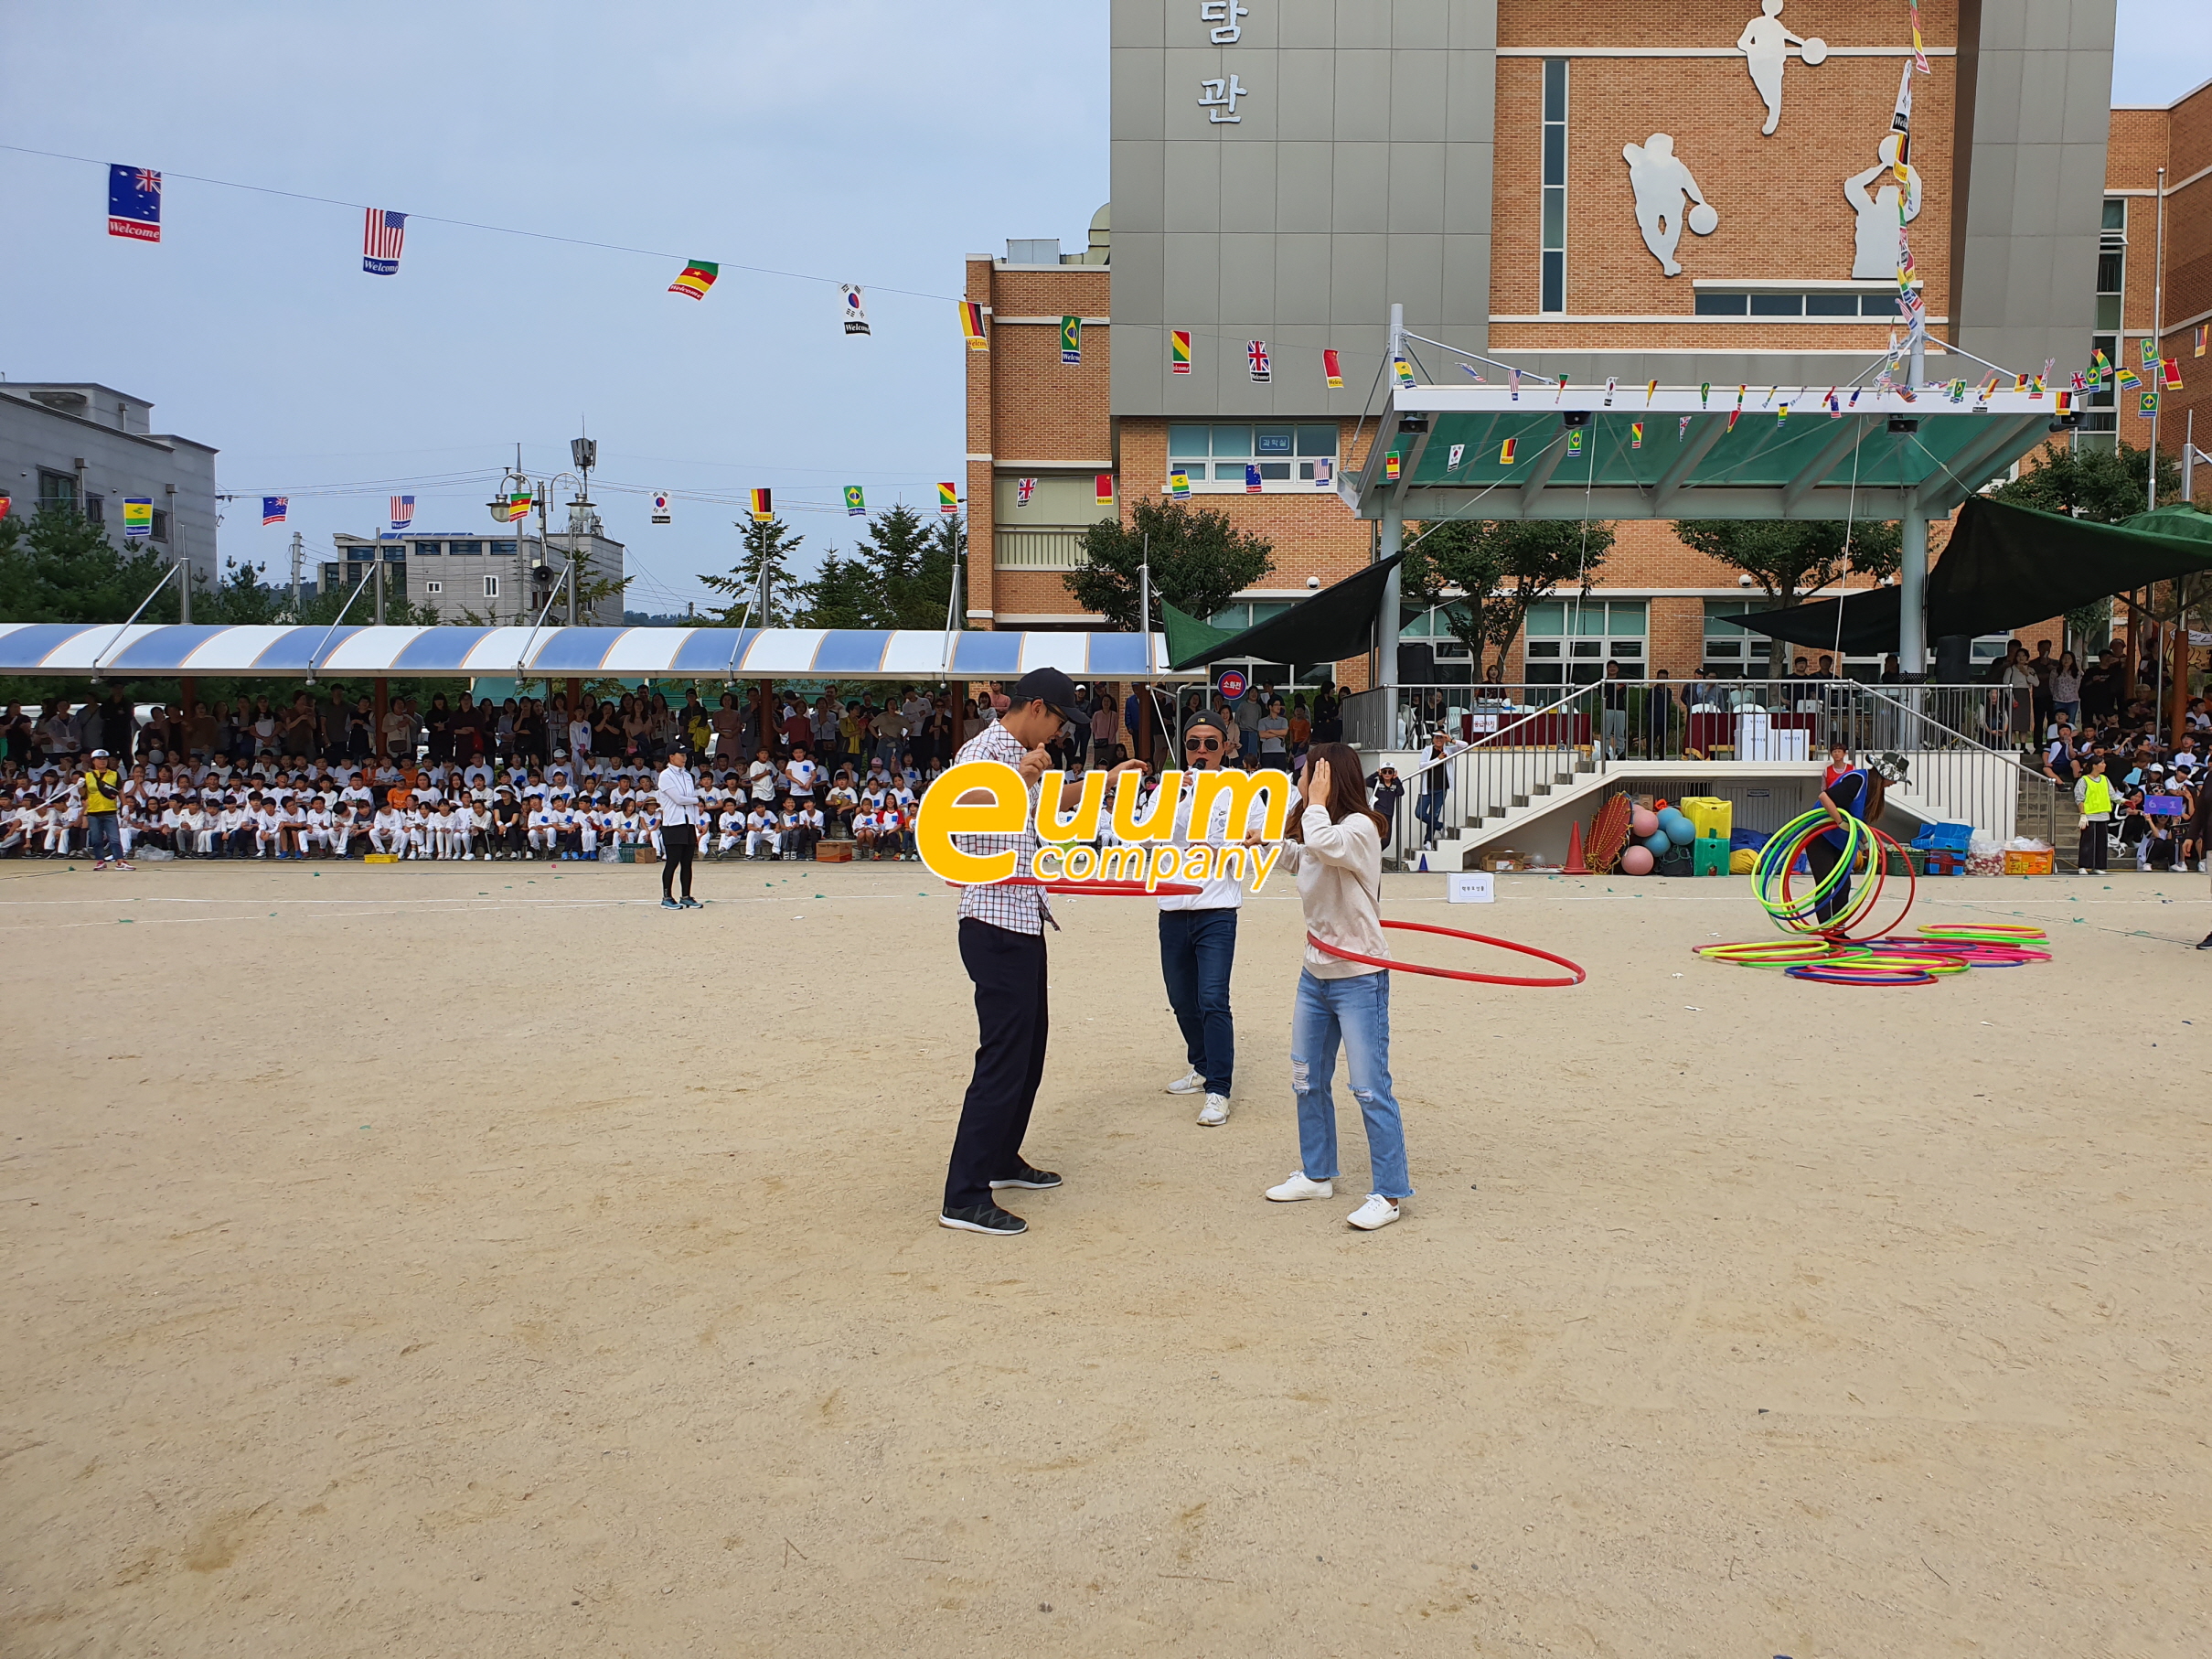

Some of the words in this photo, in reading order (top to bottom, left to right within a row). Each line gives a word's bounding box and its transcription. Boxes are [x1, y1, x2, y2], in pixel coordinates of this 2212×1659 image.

[109, 221, 160, 239] Welcome
[669, 285, 703, 298] Welcome
[1223, 680, 1242, 690] 소화전
